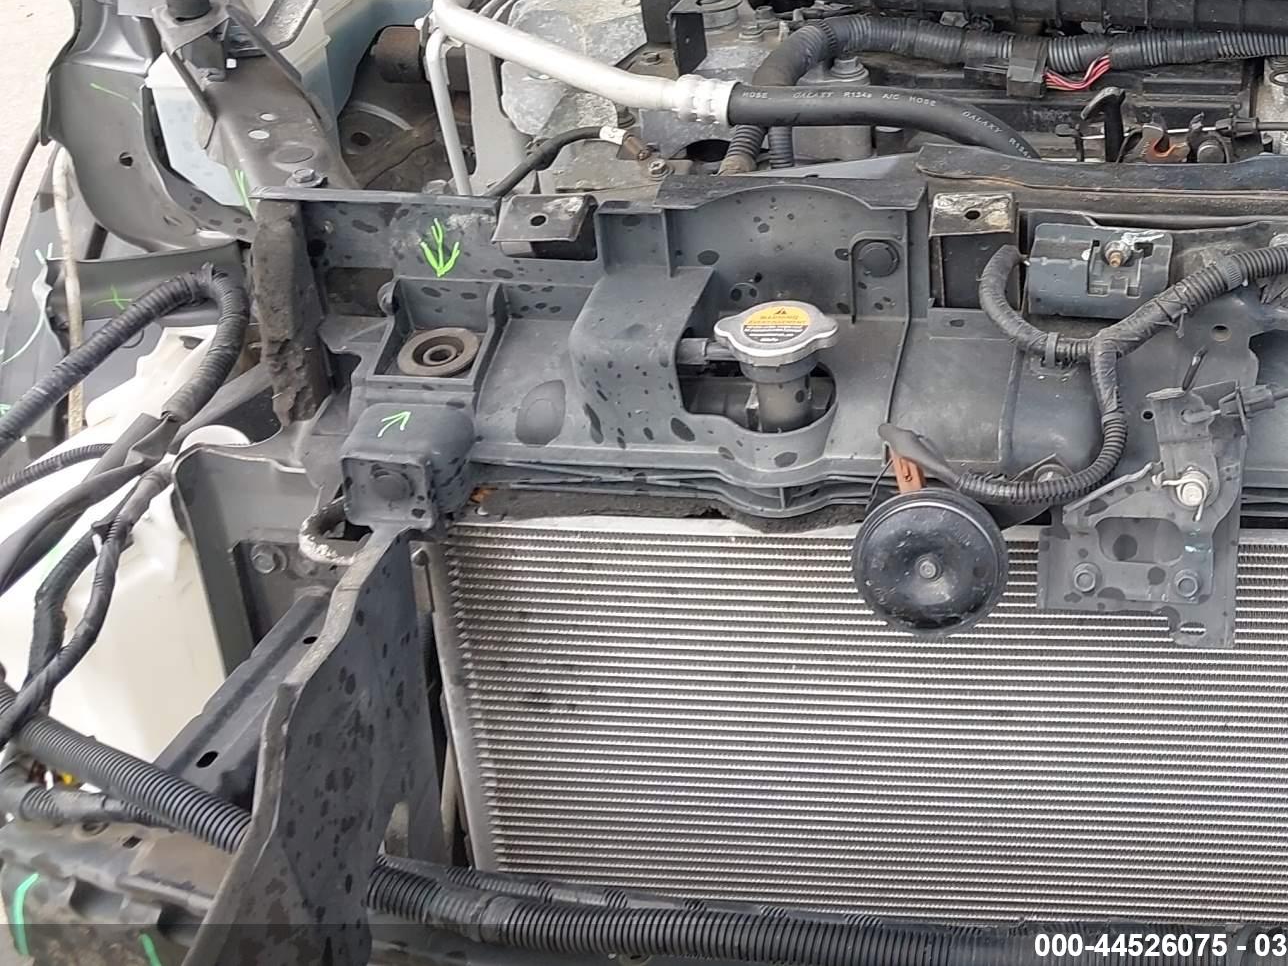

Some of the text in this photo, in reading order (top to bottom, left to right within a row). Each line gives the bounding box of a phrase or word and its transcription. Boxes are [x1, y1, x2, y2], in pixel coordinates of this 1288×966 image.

[882, 93, 901, 101] A/C
[909, 96, 938, 107] HOSE
[961, 110, 1004, 134] GALAXY
